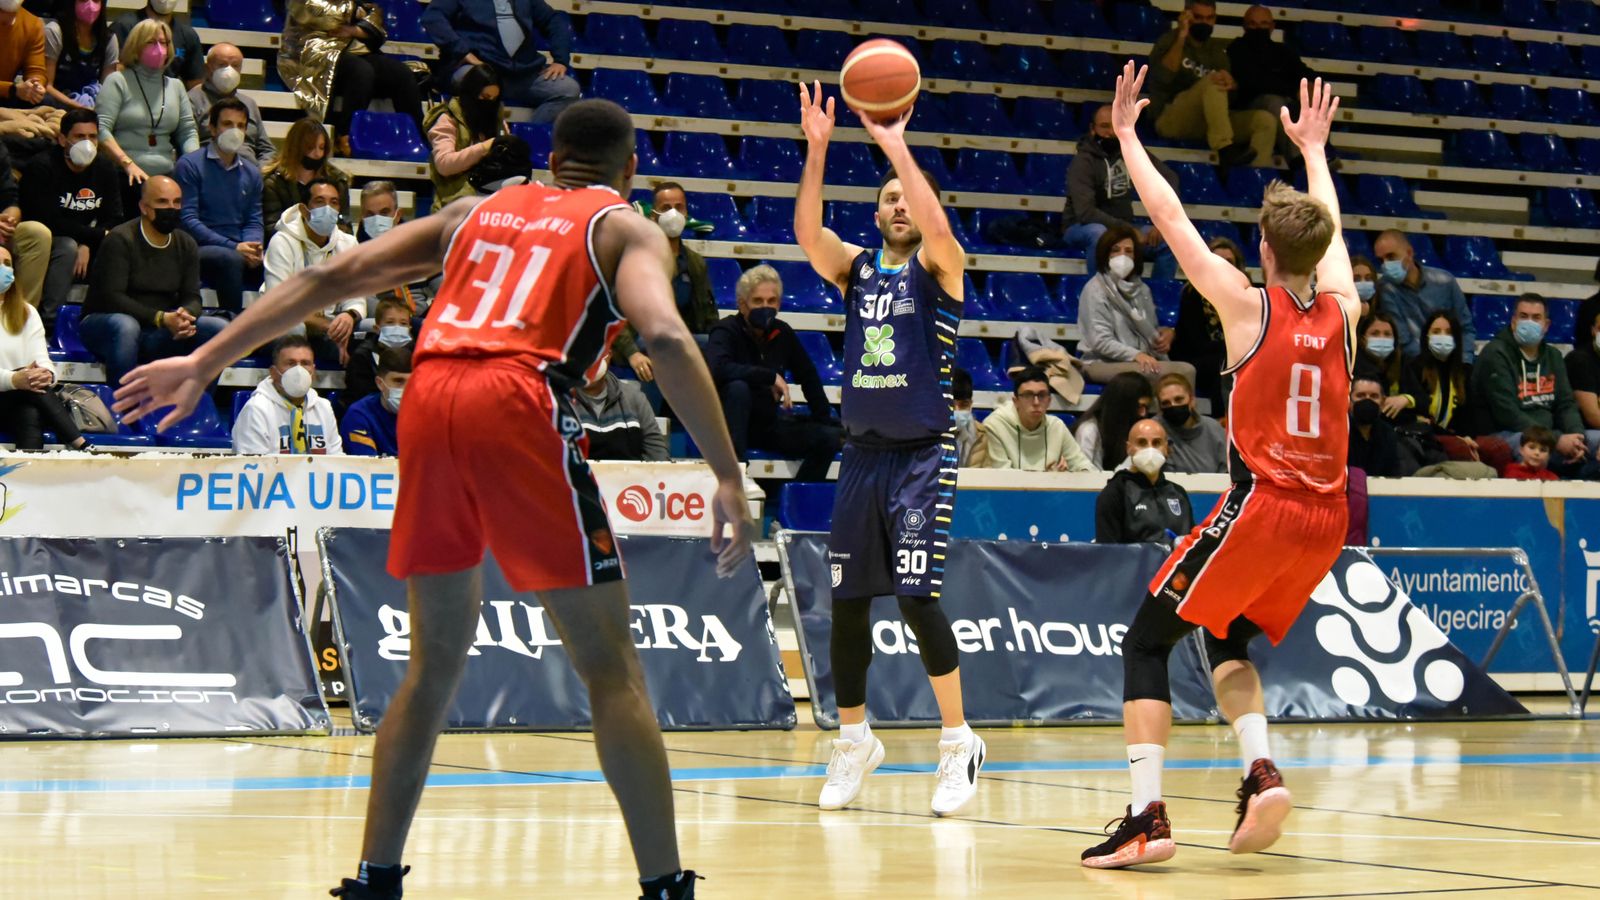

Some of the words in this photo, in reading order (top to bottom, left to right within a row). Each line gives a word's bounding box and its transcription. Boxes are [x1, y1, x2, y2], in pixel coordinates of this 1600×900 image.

[437, 239, 552, 330] 31
[860, 292, 893, 321] 30
[1294, 334, 1327, 350] FONT
[851, 369, 908, 389] damex
[1285, 362, 1321, 439] 8
[176, 463, 296, 511] PEÑA
[655, 482, 705, 520] ice
[896, 549, 927, 574] 30
[901, 576, 921, 586] vive
[1390, 566, 1532, 596] Ayuntamiento
